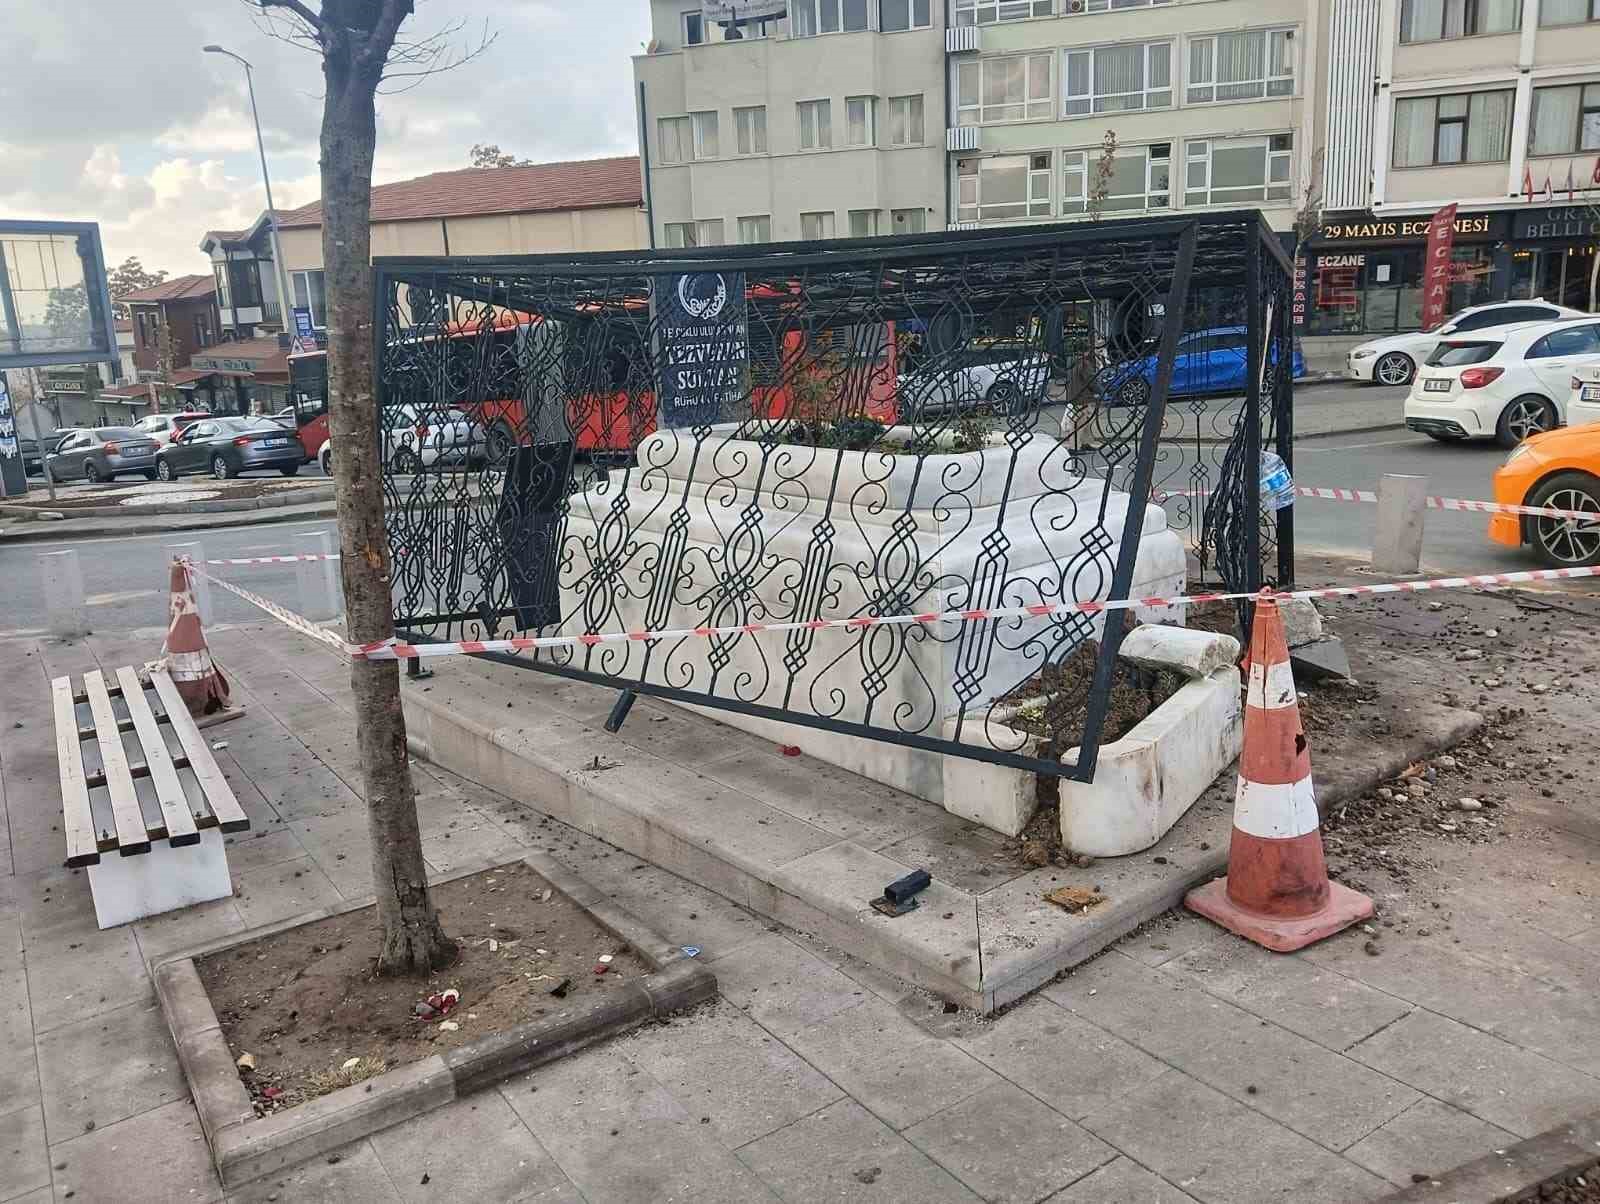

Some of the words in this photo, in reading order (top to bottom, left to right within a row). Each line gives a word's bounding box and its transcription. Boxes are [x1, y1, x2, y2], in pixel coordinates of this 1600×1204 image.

[1325, 225, 1342, 239] 29
[1345, 222, 1397, 238] MAYIS
[1402, 215, 1488, 234] ECZNESİ
[1317, 255, 1365, 267] ECZANE
